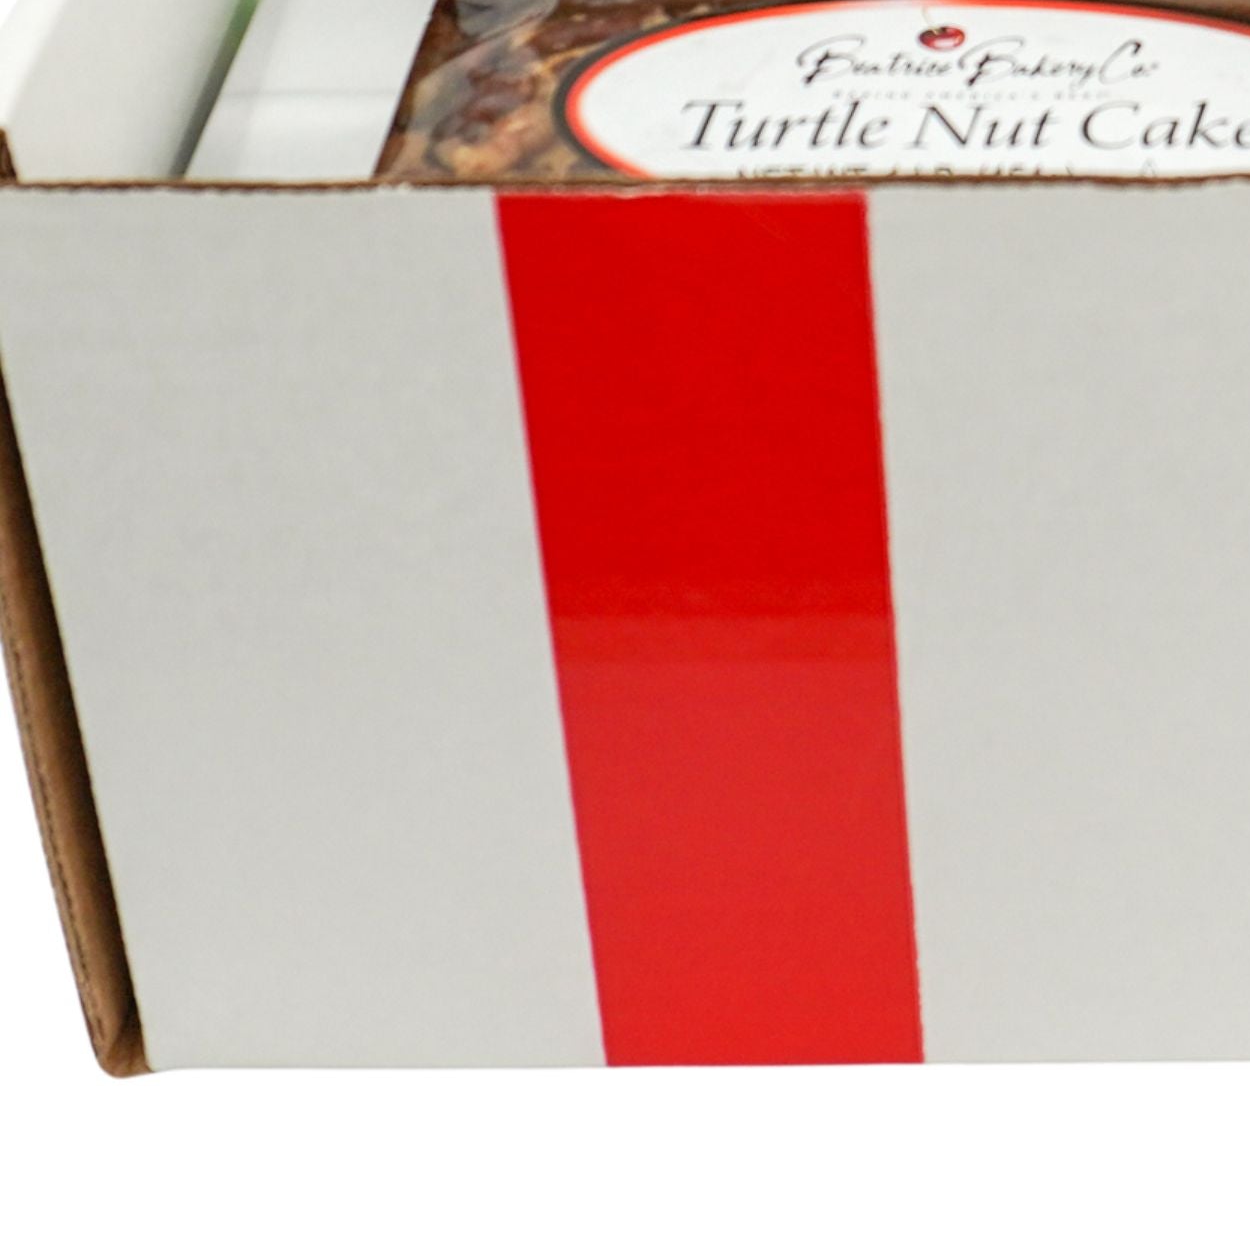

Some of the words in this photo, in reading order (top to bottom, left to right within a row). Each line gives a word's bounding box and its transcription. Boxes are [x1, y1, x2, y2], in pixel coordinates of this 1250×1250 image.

[957, 34, 1094, 93] Bakery
[681, 99, 890, 150] Turtle
[903, 104, 1059, 149] Nut
